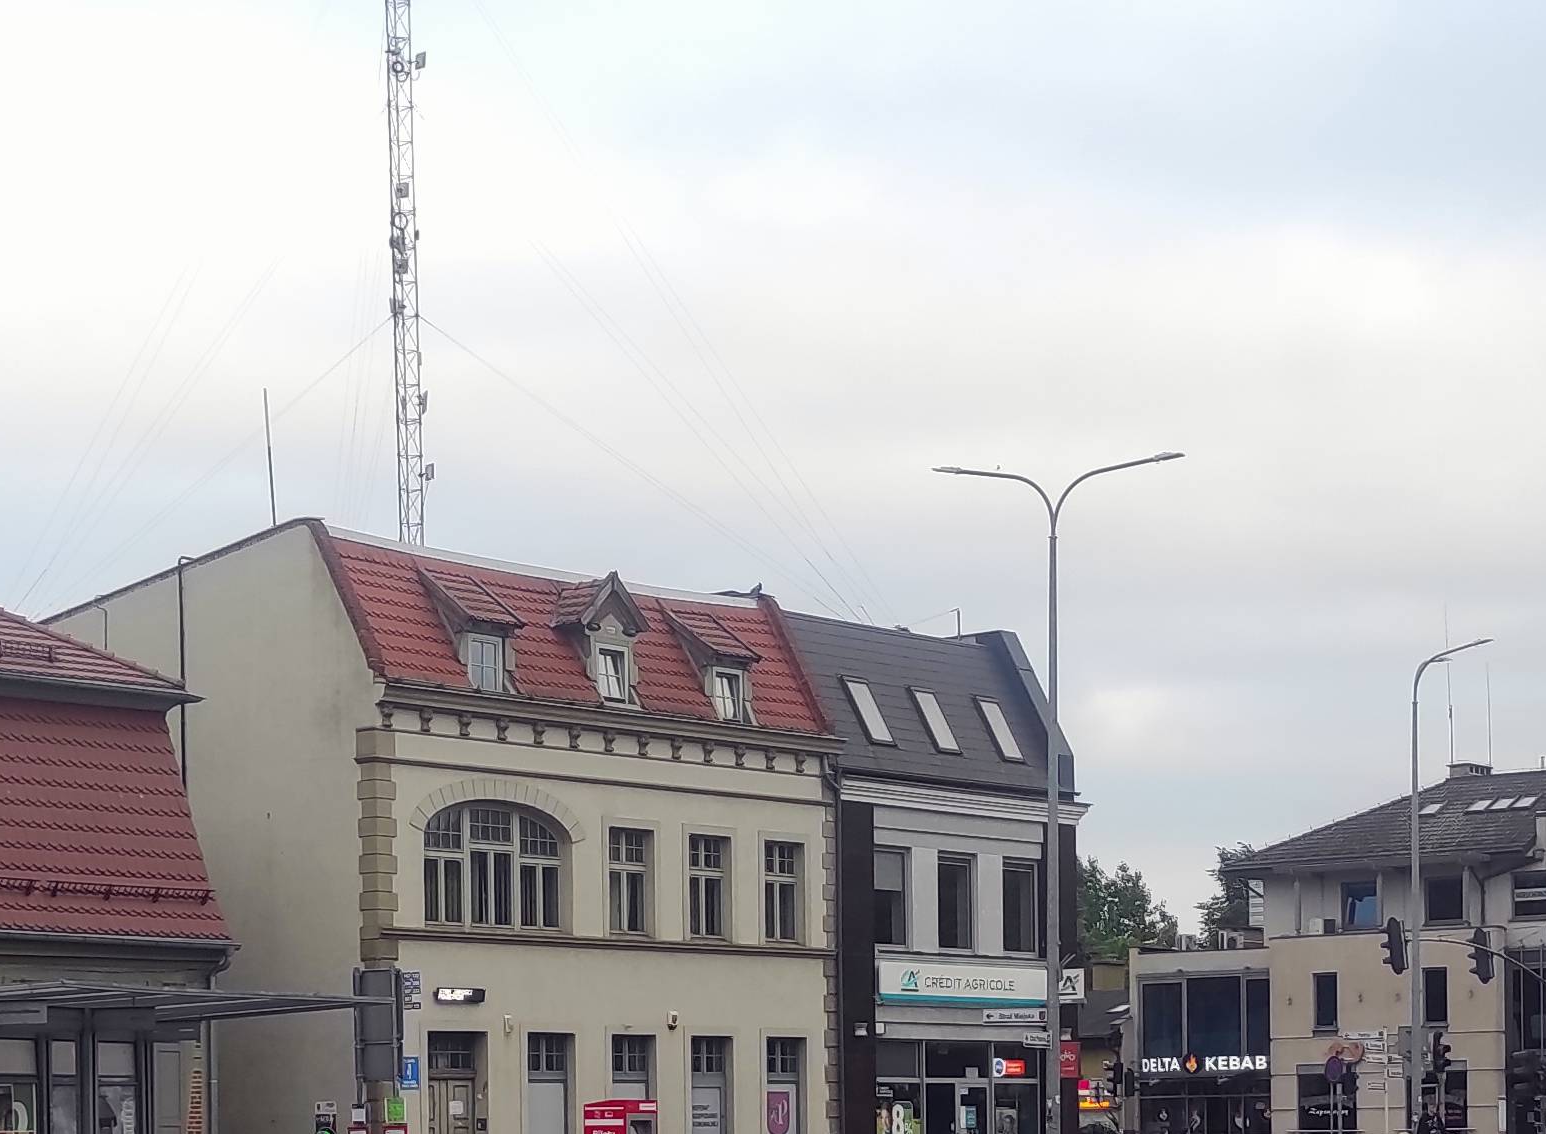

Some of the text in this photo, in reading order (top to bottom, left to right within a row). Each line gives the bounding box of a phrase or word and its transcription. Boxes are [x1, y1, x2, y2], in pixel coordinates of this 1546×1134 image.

[924, 974, 1015, 991] CRÉDIT AGRICOLE
[1141, 1055, 1268, 1072] DELTA KEBAB
